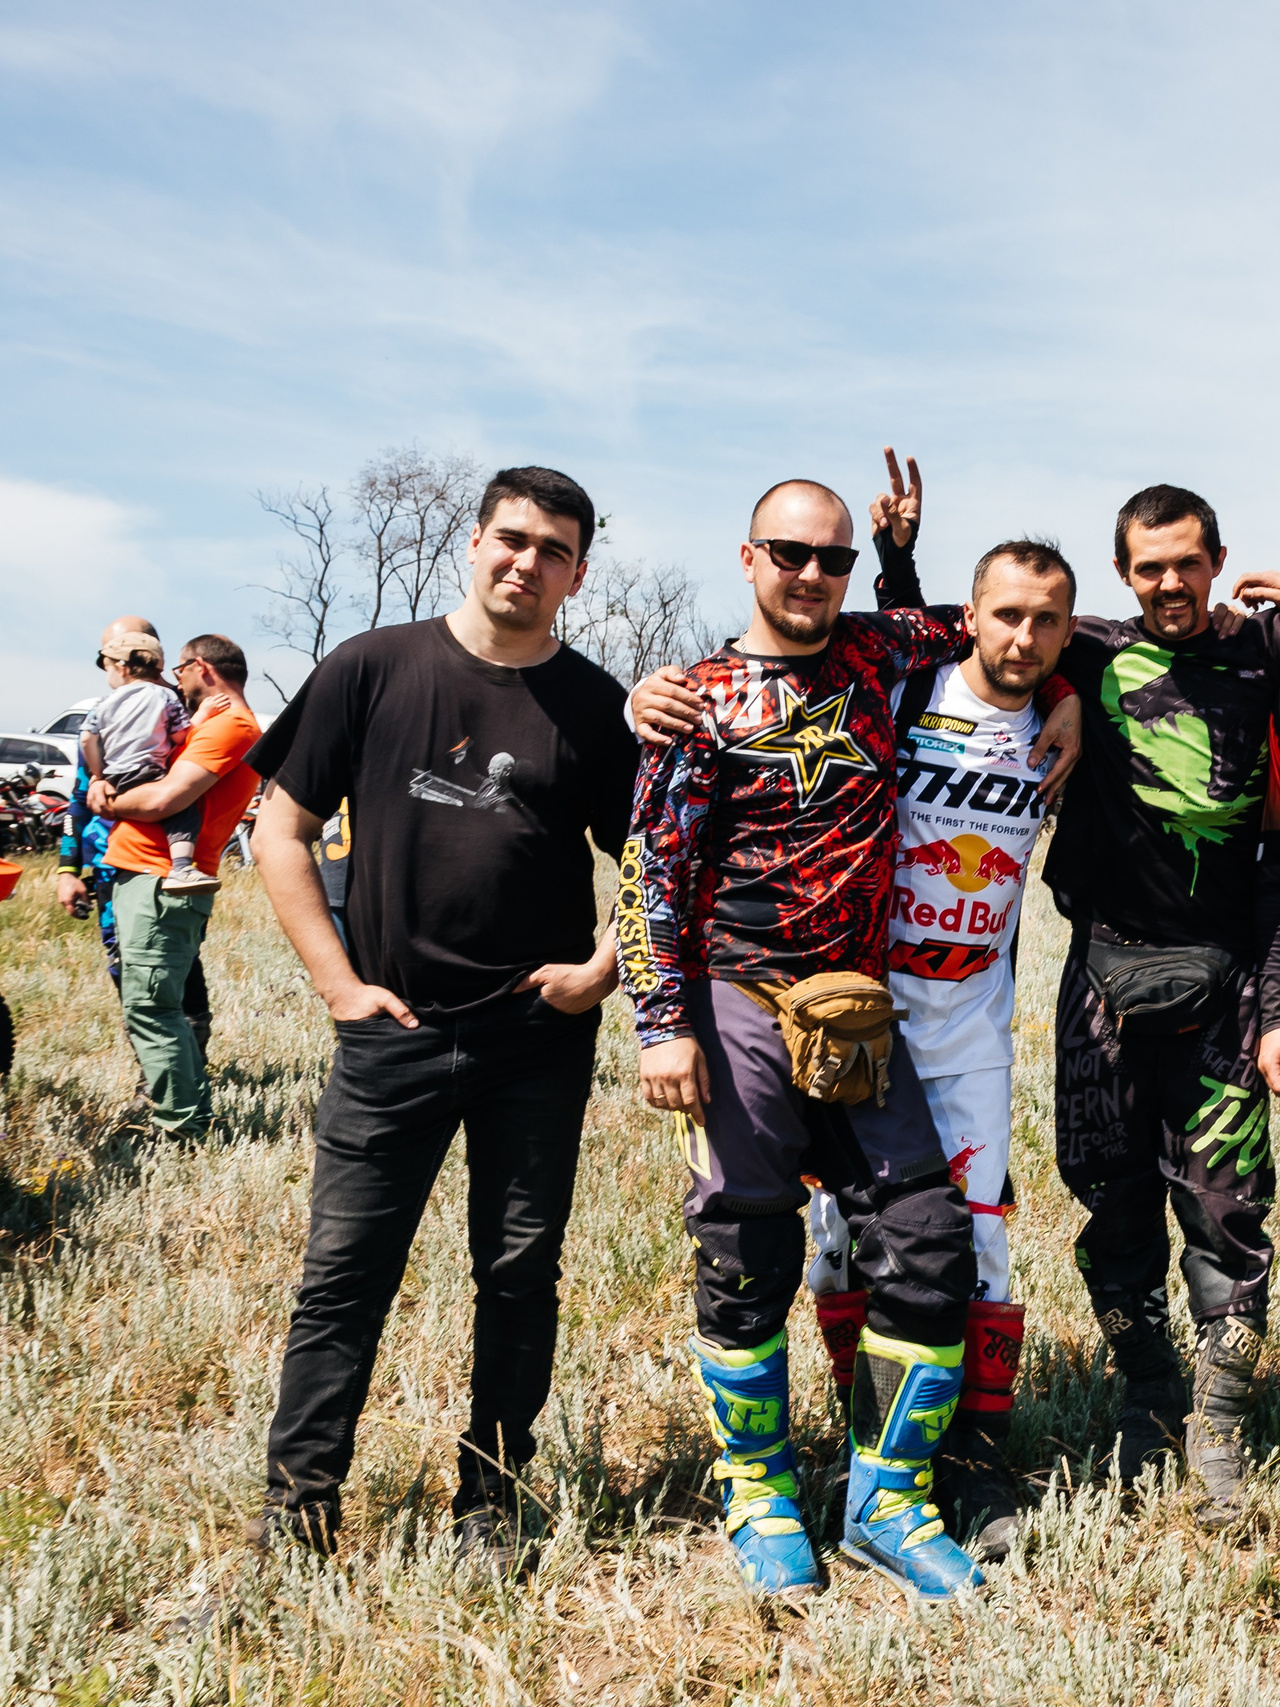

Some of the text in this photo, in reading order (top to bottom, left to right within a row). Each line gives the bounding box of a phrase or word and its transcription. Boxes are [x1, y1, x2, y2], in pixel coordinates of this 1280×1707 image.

[908, 734, 962, 753] TOREX
[910, 811, 1030, 836] THE FIRST THE FOREVER
[889, 885, 965, 933] Red
